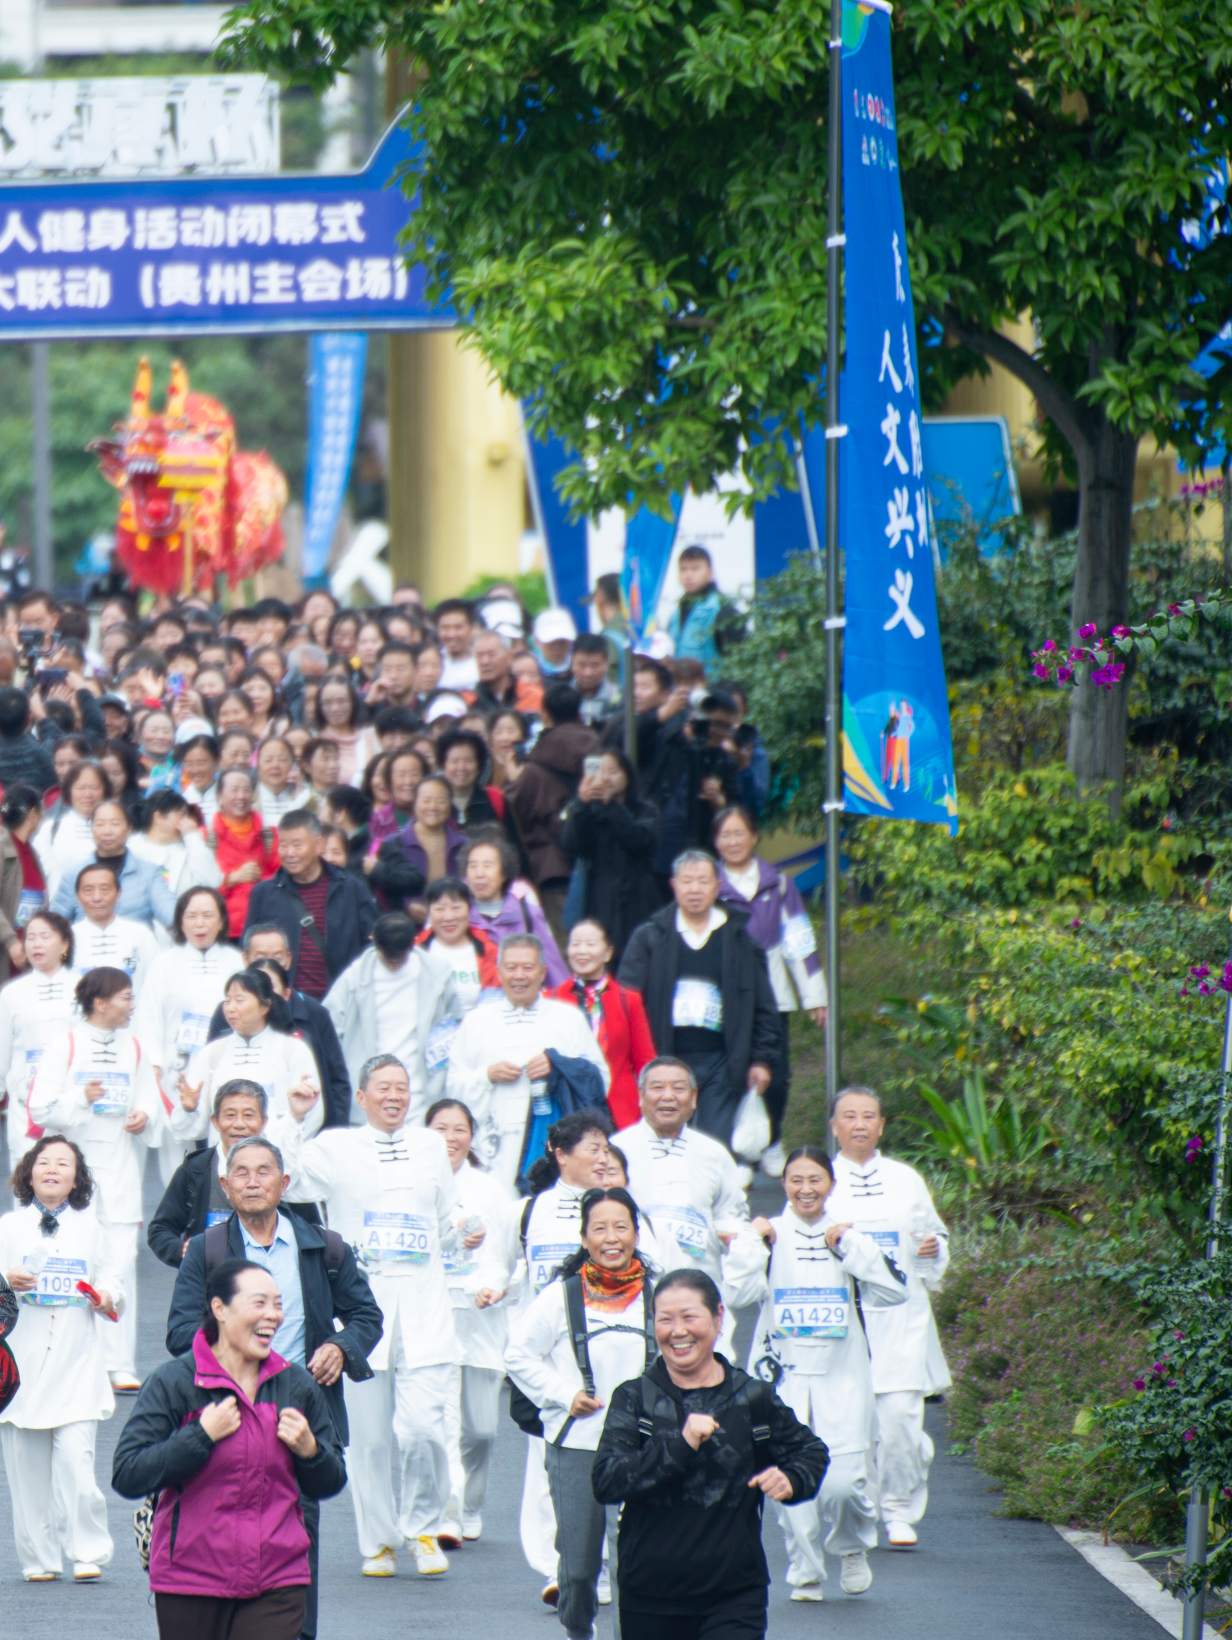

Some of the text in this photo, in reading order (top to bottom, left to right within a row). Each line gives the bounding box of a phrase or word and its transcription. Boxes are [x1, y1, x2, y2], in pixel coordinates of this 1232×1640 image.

[878, 329, 926, 640] 人文兴义
[367, 1230, 428, 1250] A1420
[780, 1306, 845, 1325] A1429
